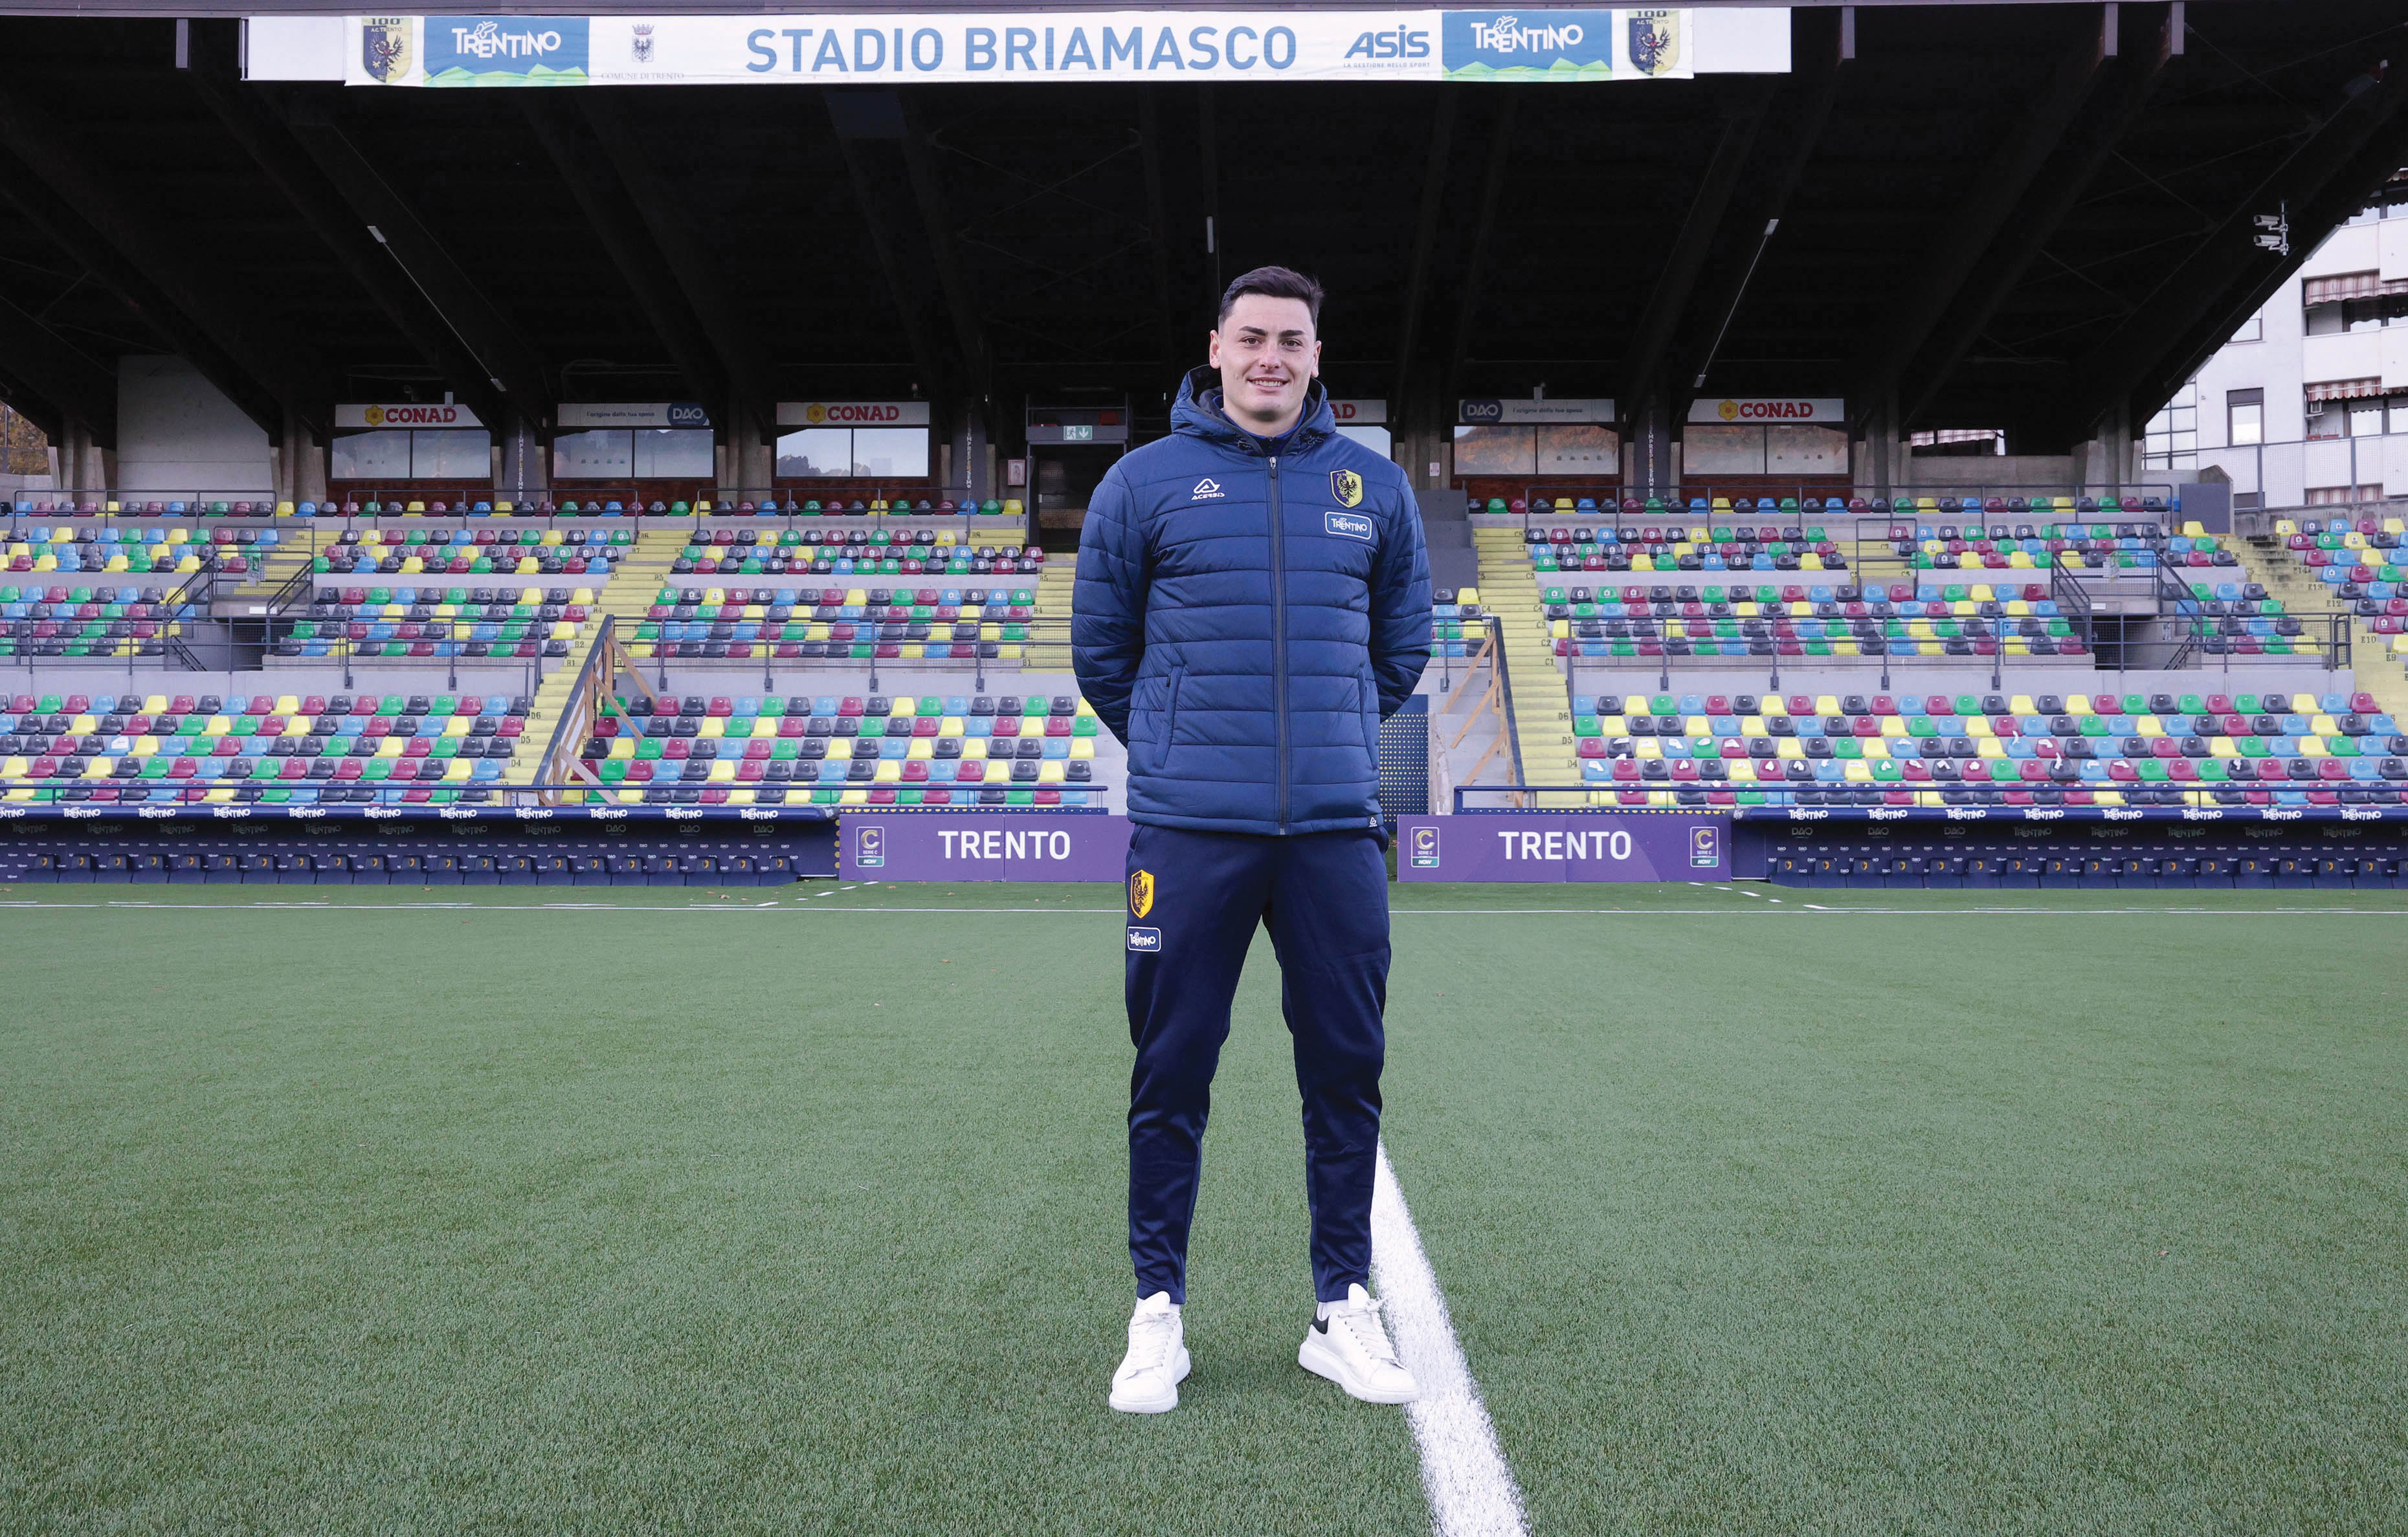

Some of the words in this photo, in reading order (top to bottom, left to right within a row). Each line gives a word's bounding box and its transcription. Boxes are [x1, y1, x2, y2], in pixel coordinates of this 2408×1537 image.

[452, 27, 561, 58] TRENTINO
[1470, 22, 1583, 53] TRENTINO
[746, 28, 943, 72] STADIO
[965, 25, 1296, 71] BRIAMASCO
[386, 408, 456, 423] CONAD
[673, 408, 704, 419] DAO
[827, 406, 899, 421] CONAD
[1467, 404, 1499, 416] DAO
[1739, 403, 1813, 417] CONAD
[1331, 518, 1367, 532] TRENTINO
[0, 808, 25, 819] NTINO
[63, 808, 102, 819] TRENTINO
[137, 808, 177, 819] TRENTINO
[212, 808, 251, 819] TRENTINO
[287, 808, 327, 819] TRENTINO
[362, 808, 402, 819] TRENTINO
[439, 808, 478, 819] TRENTINO
[515, 808, 553, 819] TRENTINO
[589, 808, 628, 819] TRENTINO
[664, 808, 704, 819] TRENTINO
[739, 808, 779, 819] TRENTINO
[1788, 808, 1829, 820] TRENTINO
[1867, 808, 1908, 820] TRENTINO
[1945, 808, 1987, 820] TRENTINO
[2023, 808, 2064, 820] TRENTINO
[2102, 808, 2143, 820] TRENTINO
[2181, 808, 2223, 820] TRENTINO
[2260, 808, 2302, 820] TRENTINO
[2339, 808, 2382, 820] TRENTINO
[606, 824, 627, 834] DAO
[680, 824, 700, 834] DAO
[753, 824, 774, 834] DAO
[1792, 827, 1812, 835] DAO
[1868, 827, 1889, 835] DAO
[1945, 827, 1965, 835] DAO
[937, 830, 1071, 859] TRENTO
[1498, 830, 1631, 860] TRENTO
